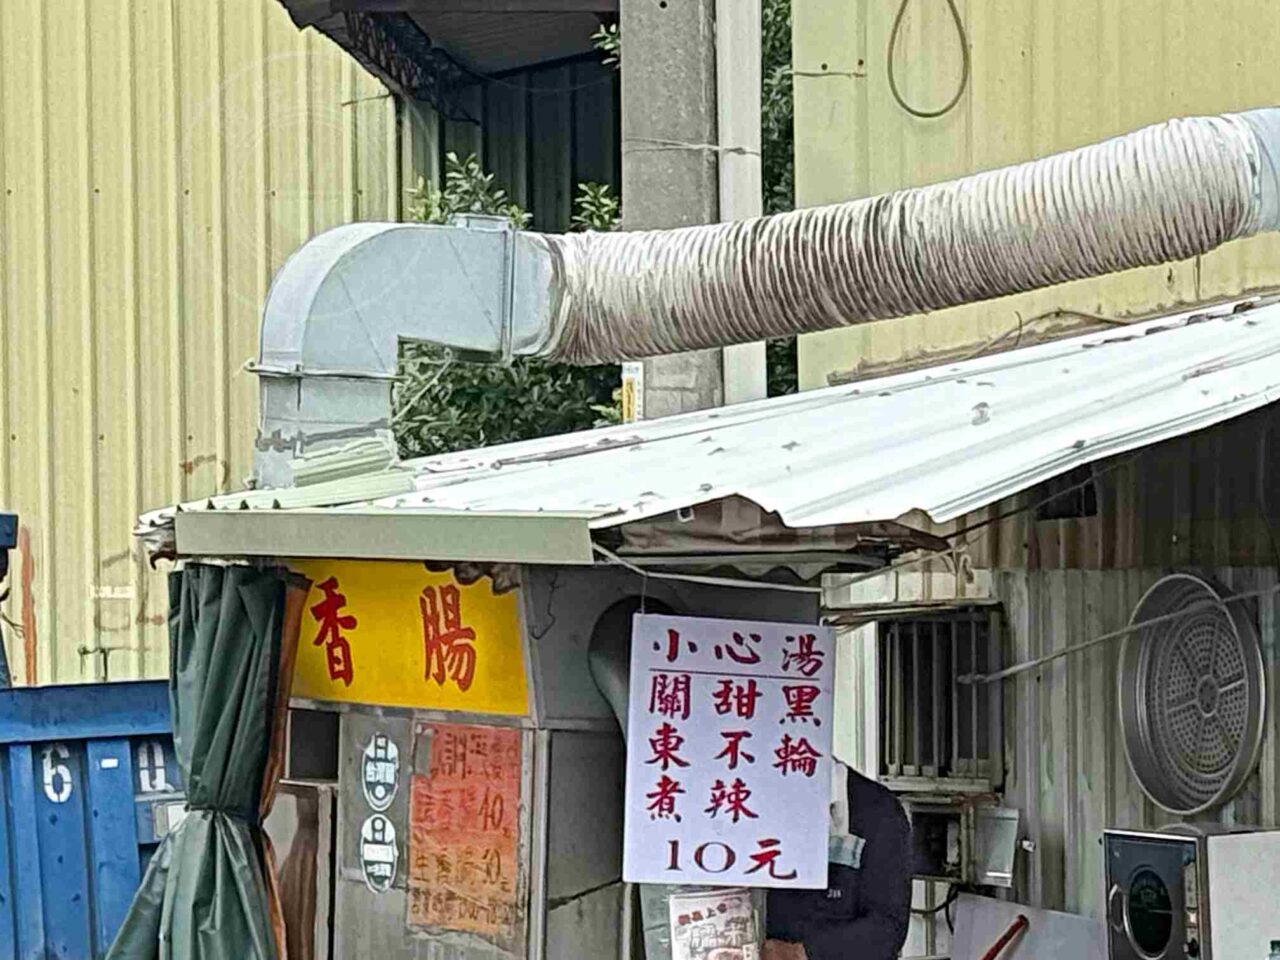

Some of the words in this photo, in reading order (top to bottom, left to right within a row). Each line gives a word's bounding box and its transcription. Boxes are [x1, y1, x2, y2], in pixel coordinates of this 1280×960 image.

[310, 576, 476, 693] 香腸
[644, 673, 692, 824] 關東煮
[703, 678, 764, 824] 甜不辣
[771, 684, 823, 779] 黑輪
